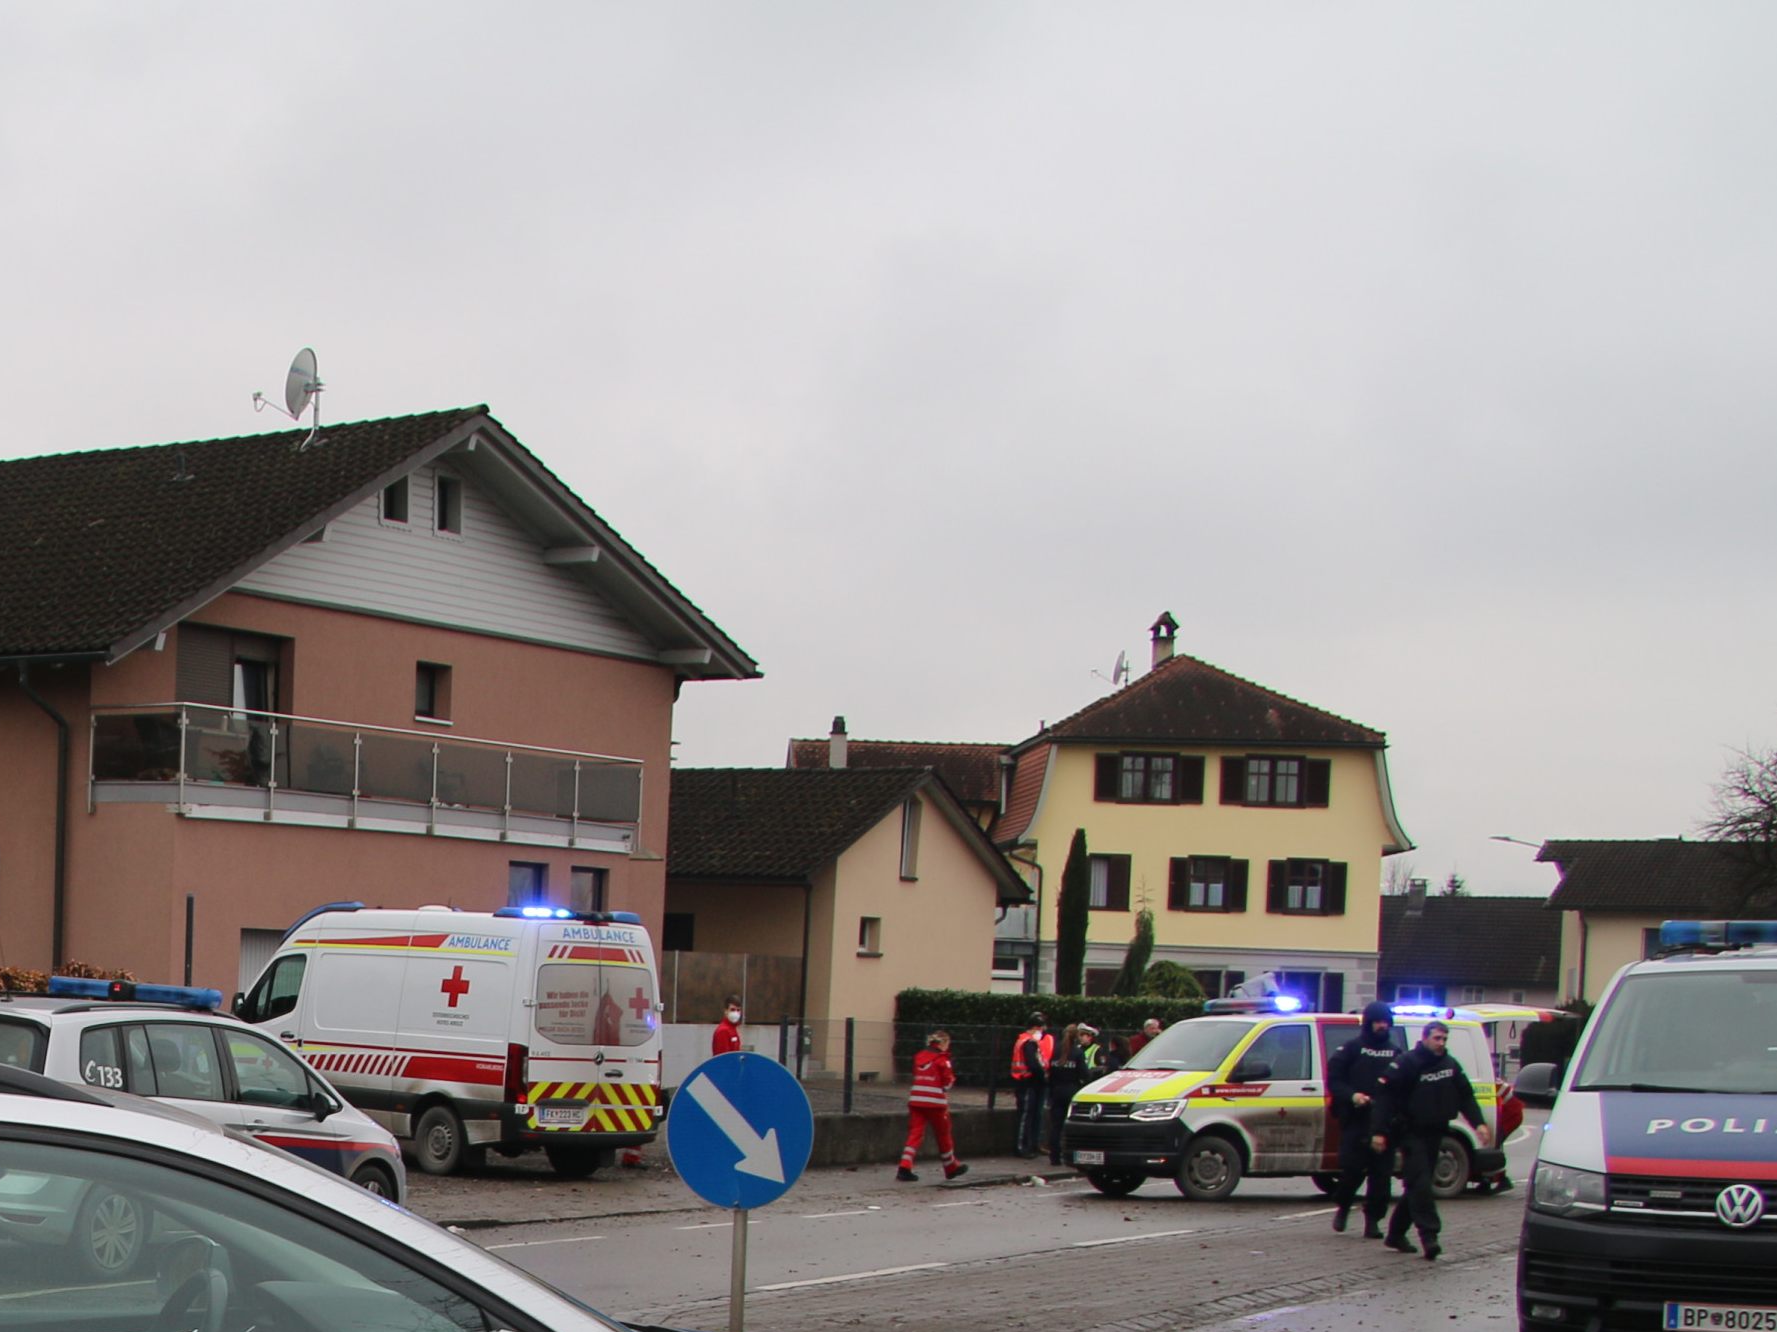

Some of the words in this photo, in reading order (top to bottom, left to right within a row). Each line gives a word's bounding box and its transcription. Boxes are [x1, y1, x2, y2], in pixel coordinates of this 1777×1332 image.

[562, 927, 636, 943] AMBULANCE
[448, 936, 511, 951] AMBULANCE
[1361, 1047, 1394, 1058] POLIZEI
[96, 1065, 123, 1088] 133
[1420, 1068, 1454, 1082] POLIZEI
[1646, 1117, 1777, 1134] POLI
[1684, 1308, 1709, 1328] BP
[1725, 1310, 1777, 1331] 8025
